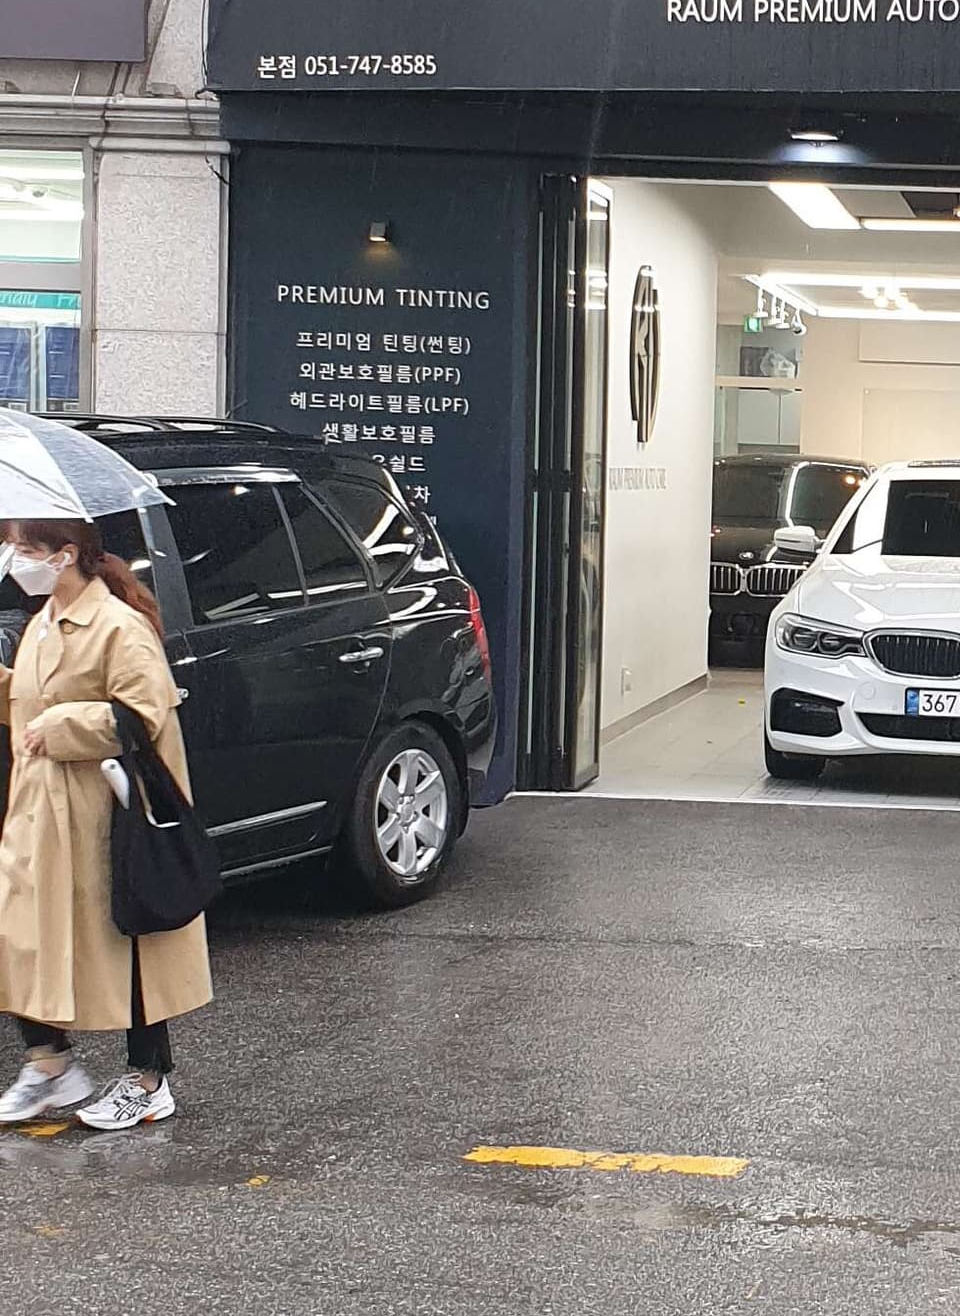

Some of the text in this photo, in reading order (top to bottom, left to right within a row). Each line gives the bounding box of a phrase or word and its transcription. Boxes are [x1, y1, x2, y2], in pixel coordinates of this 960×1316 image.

[257, 54, 437, 79] 본점 051-747-8585
[277, 284, 491, 309] PREMIUM TINTING
[296, 331, 472, 355] 프리미엄 틴팅(썬팅)
[299, 361, 462, 385] 외관보호필름(PPF)
[289, 391, 470, 415] 헤드라이트필름(LPF)
[322, 422, 436, 445] 생활보호필름
